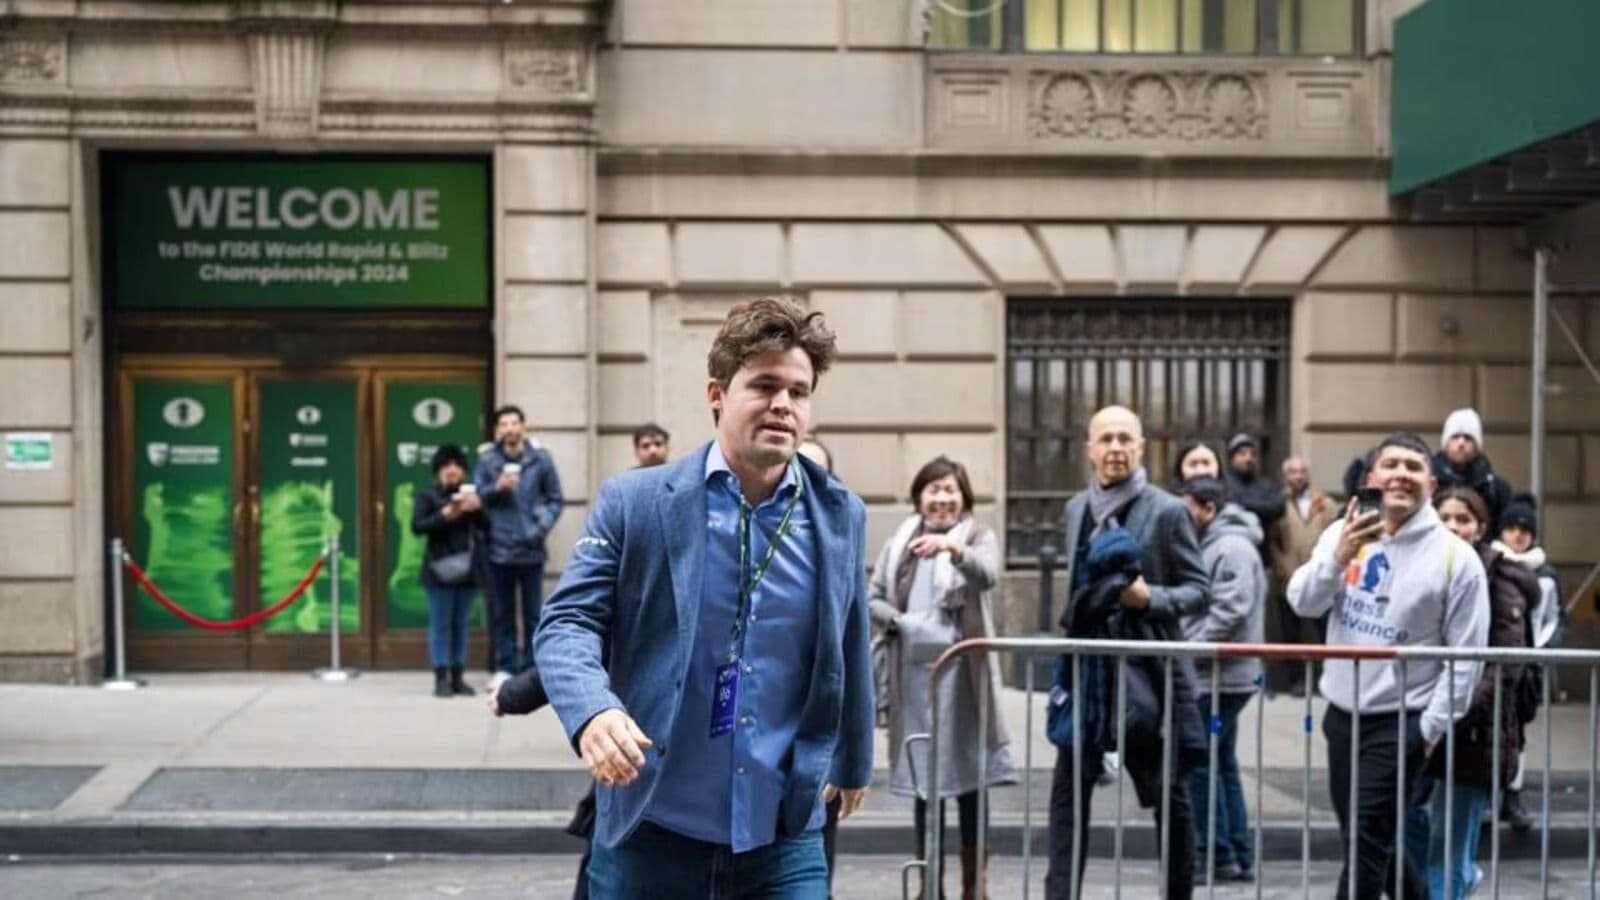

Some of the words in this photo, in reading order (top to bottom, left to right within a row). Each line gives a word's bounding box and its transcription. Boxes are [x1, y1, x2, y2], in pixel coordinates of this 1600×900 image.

[168, 187, 440, 229] WELCOME
[159, 243, 180, 258] to
[184, 243, 216, 258] the
[220, 243, 260, 259] FIDE
[265, 243, 324, 259] World
[328, 243, 385, 263] Rapid
[389, 244, 403, 260] &
[408, 244, 448, 260] Blitz
[199, 264, 356, 285] Championships
[360, 265, 408, 281] 2024
